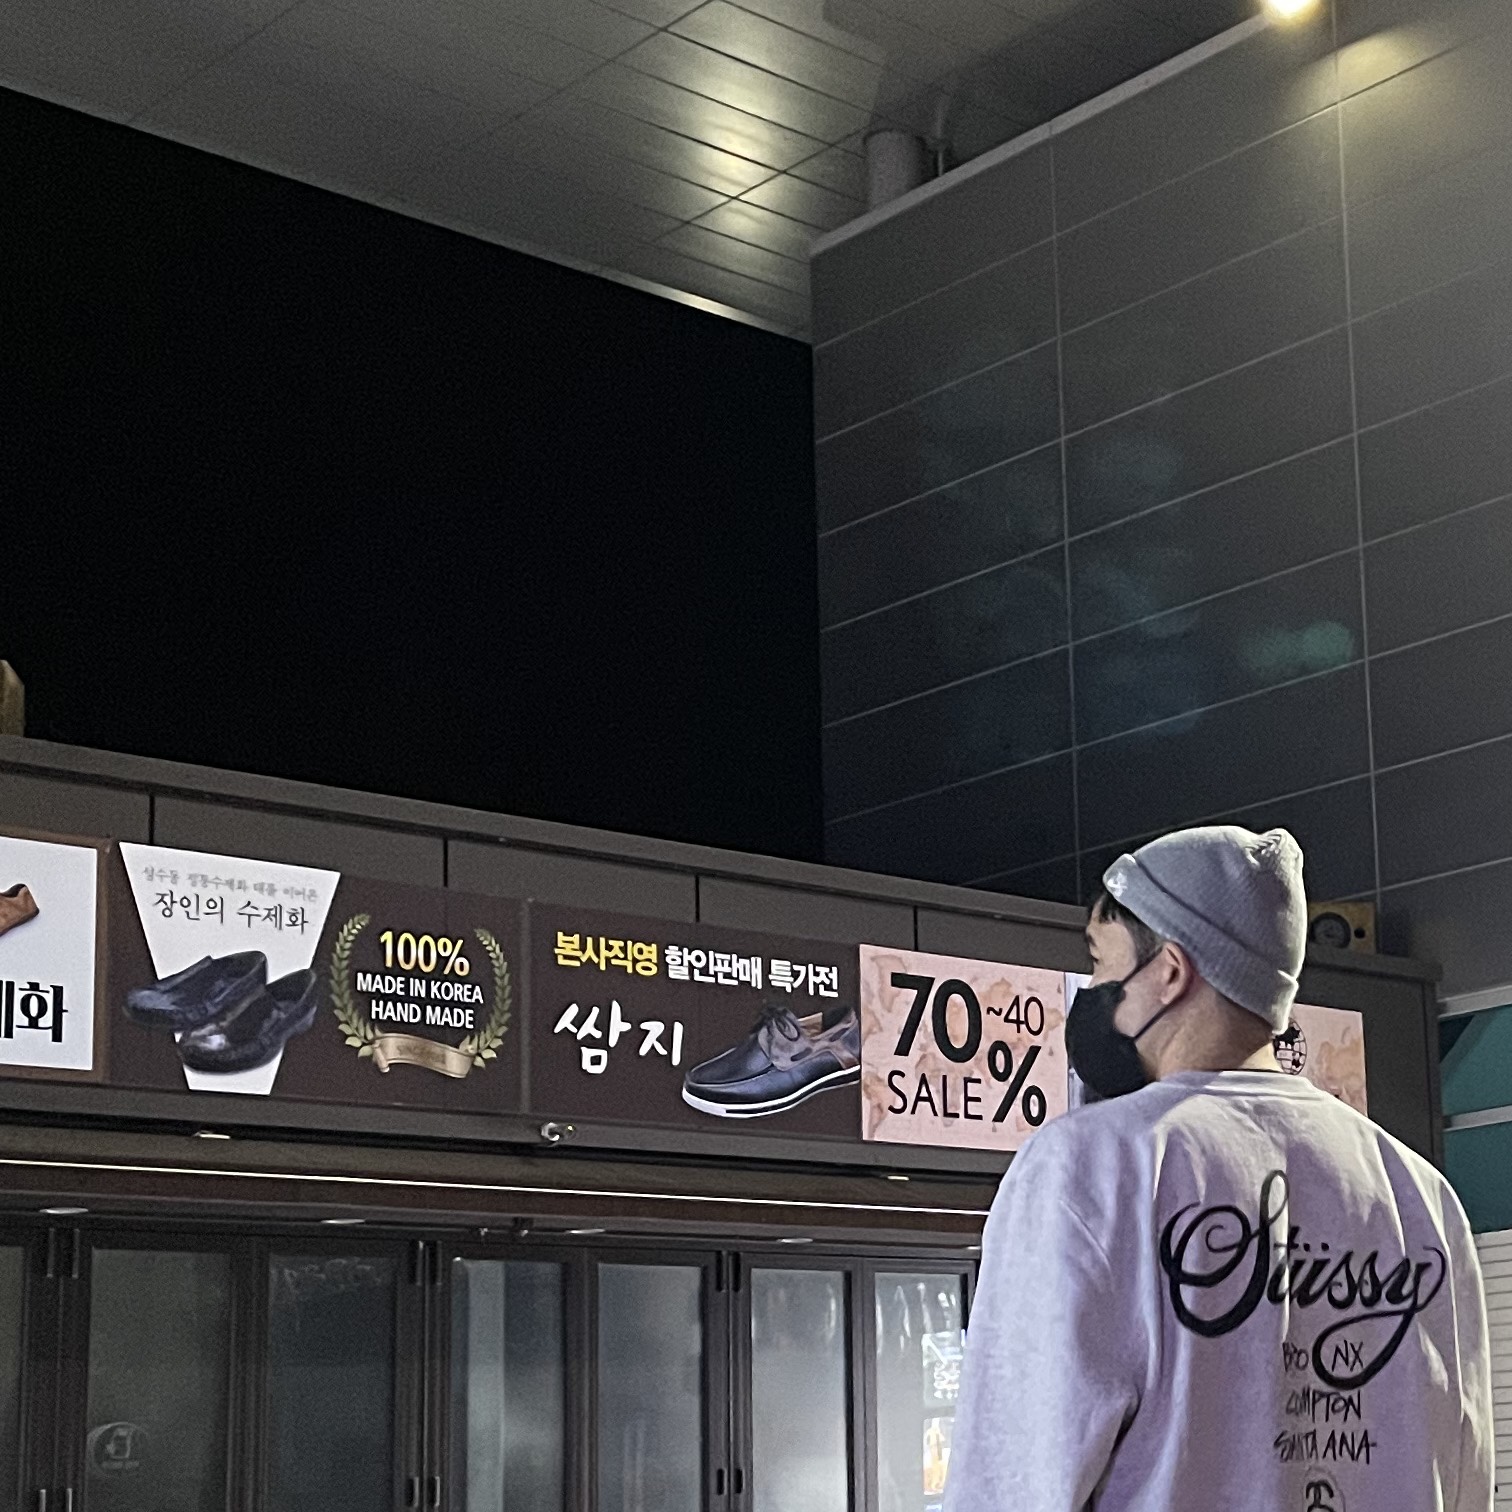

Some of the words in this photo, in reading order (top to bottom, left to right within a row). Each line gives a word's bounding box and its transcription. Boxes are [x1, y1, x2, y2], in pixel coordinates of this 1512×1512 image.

[152, 890, 225, 925] 장인의
[236, 901, 309, 935] 수제화
[379, 930, 470, 977] 100%
[554, 931, 658, 977] 본사직영
[664, 945, 763, 990] 할인판매
[768, 959, 839, 998] 특가전
[356, 972, 406, 996] MADE
[409, 977, 427, 998] IN
[430, 980, 484, 1004] KOREA
[371, 999, 422, 1023] HAND
[425, 1005, 474, 1029] MADE
[887, 1069, 984, 1121] SALE
